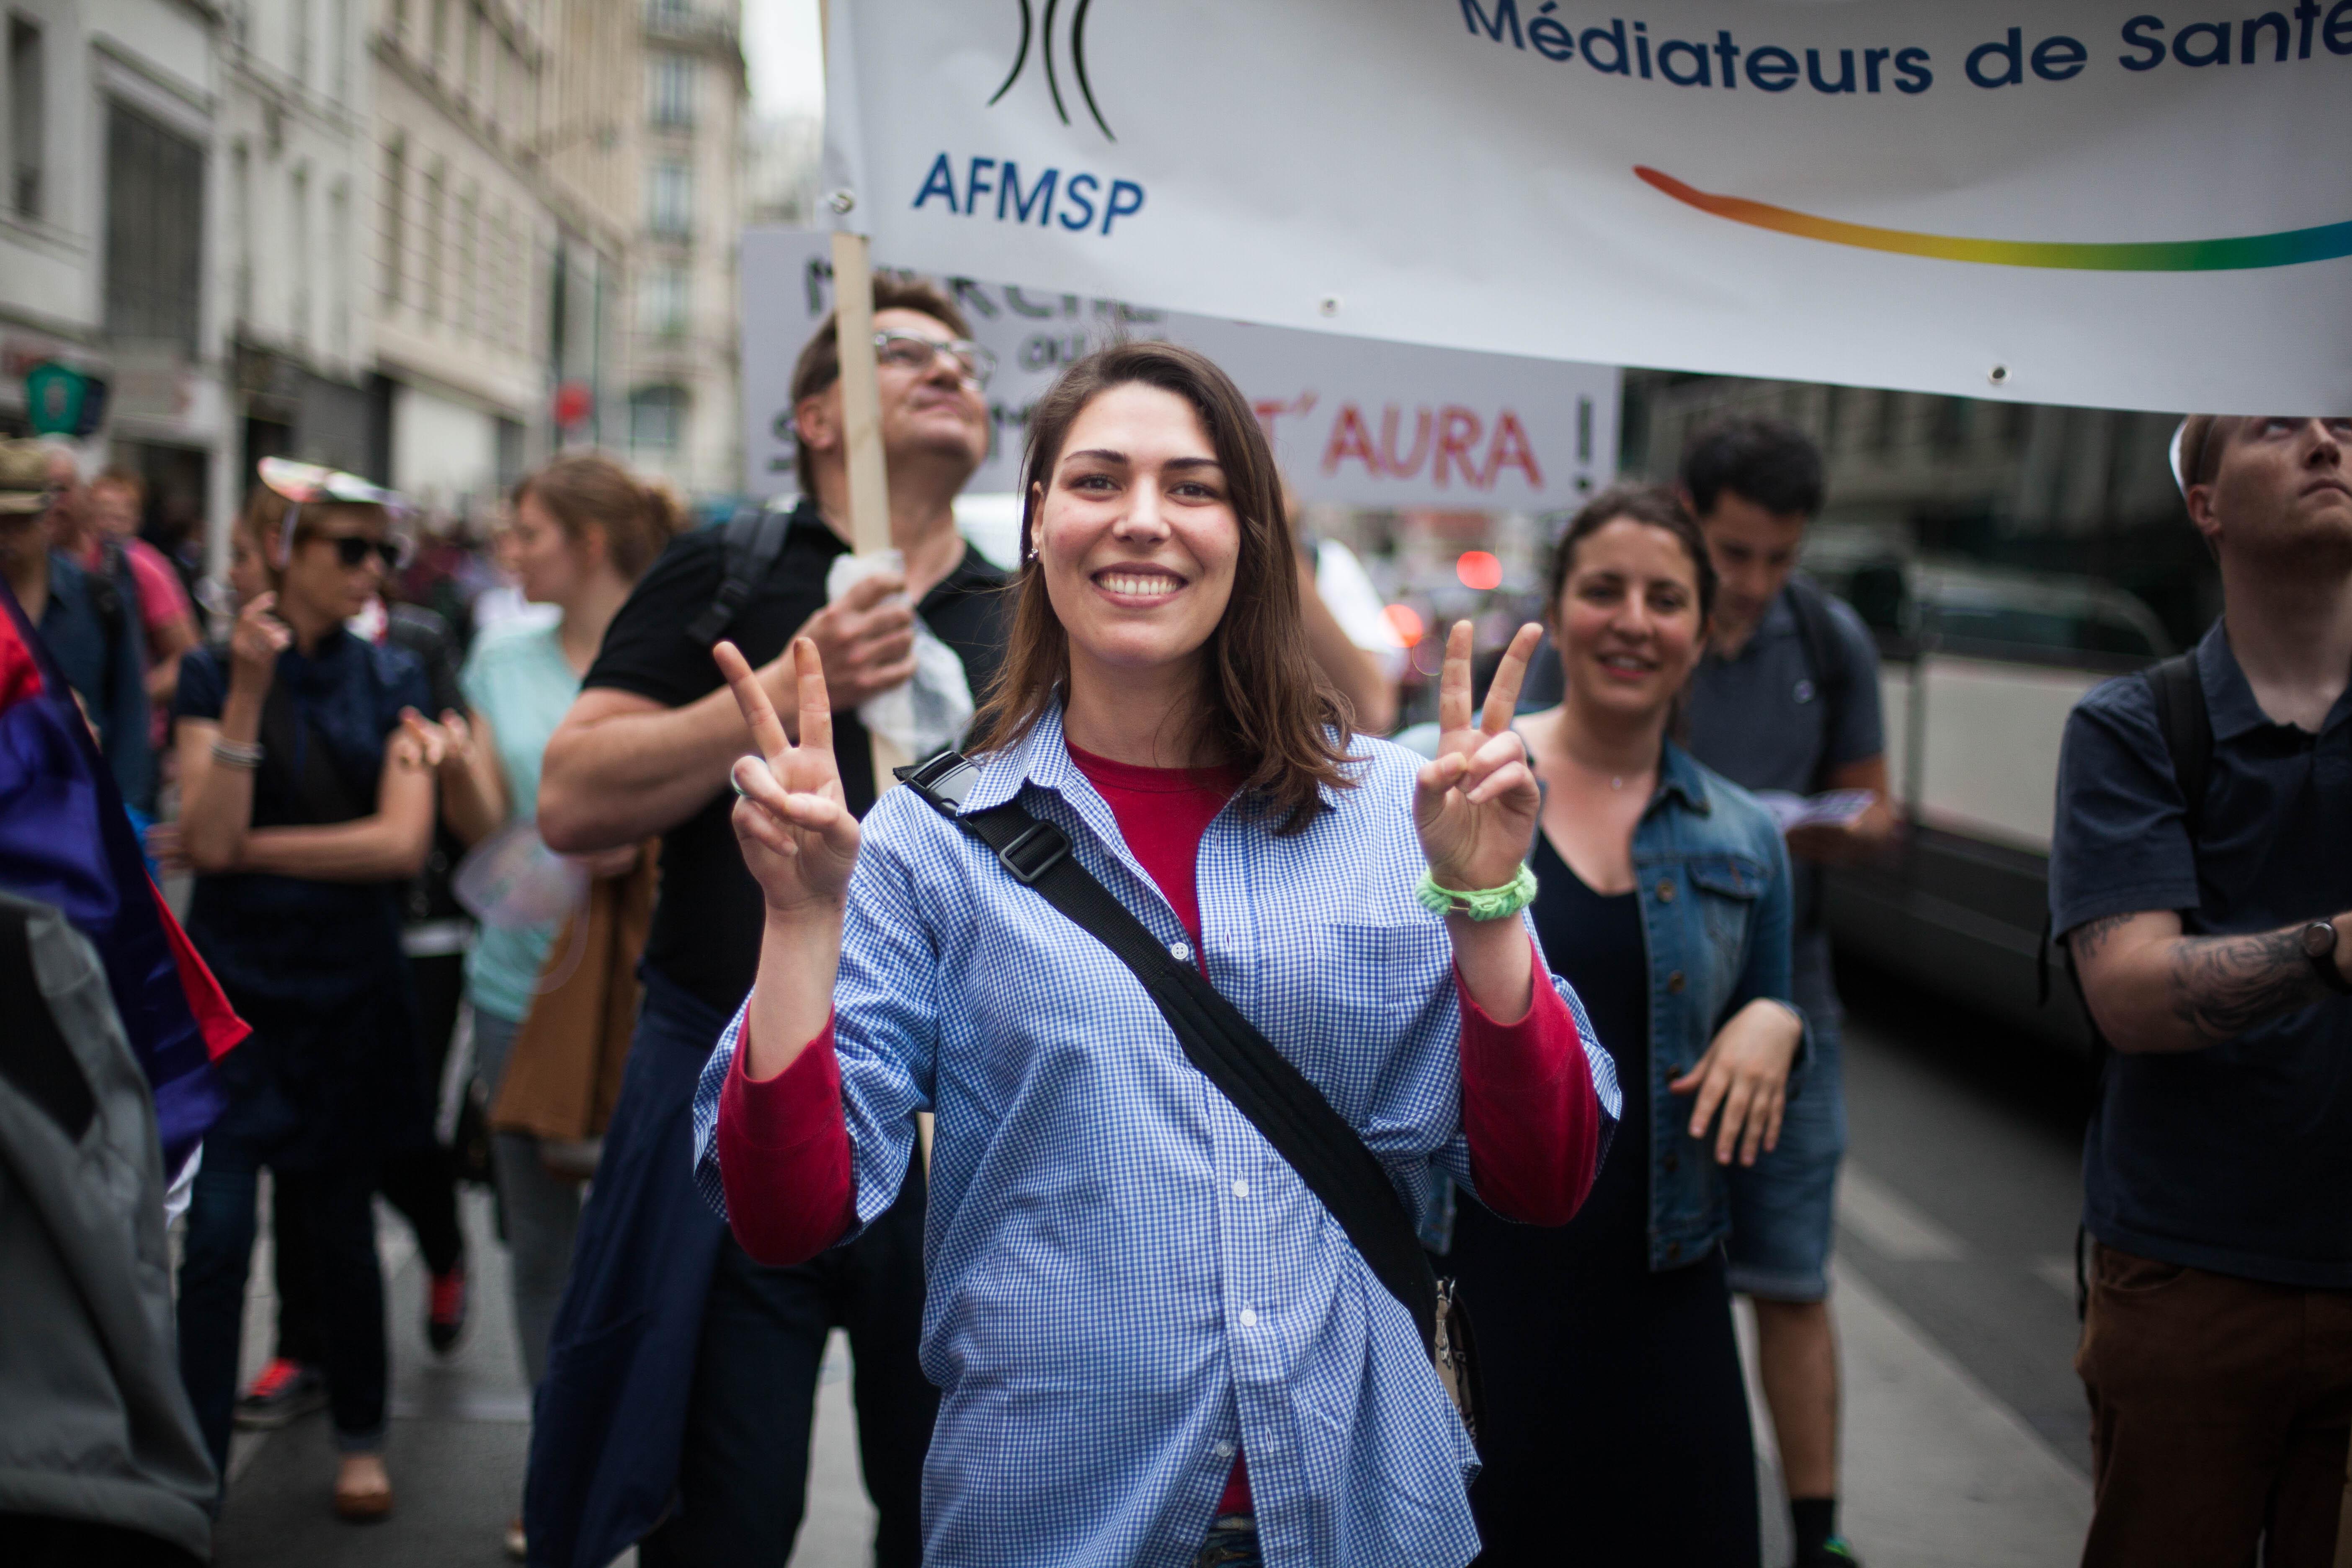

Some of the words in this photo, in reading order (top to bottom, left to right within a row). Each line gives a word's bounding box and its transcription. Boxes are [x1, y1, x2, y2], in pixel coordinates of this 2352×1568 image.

[1458, 0, 1934, 95] Médiateurs
[1965, 27, 2088, 89] de
[912, 152, 1146, 237] AFMSP
